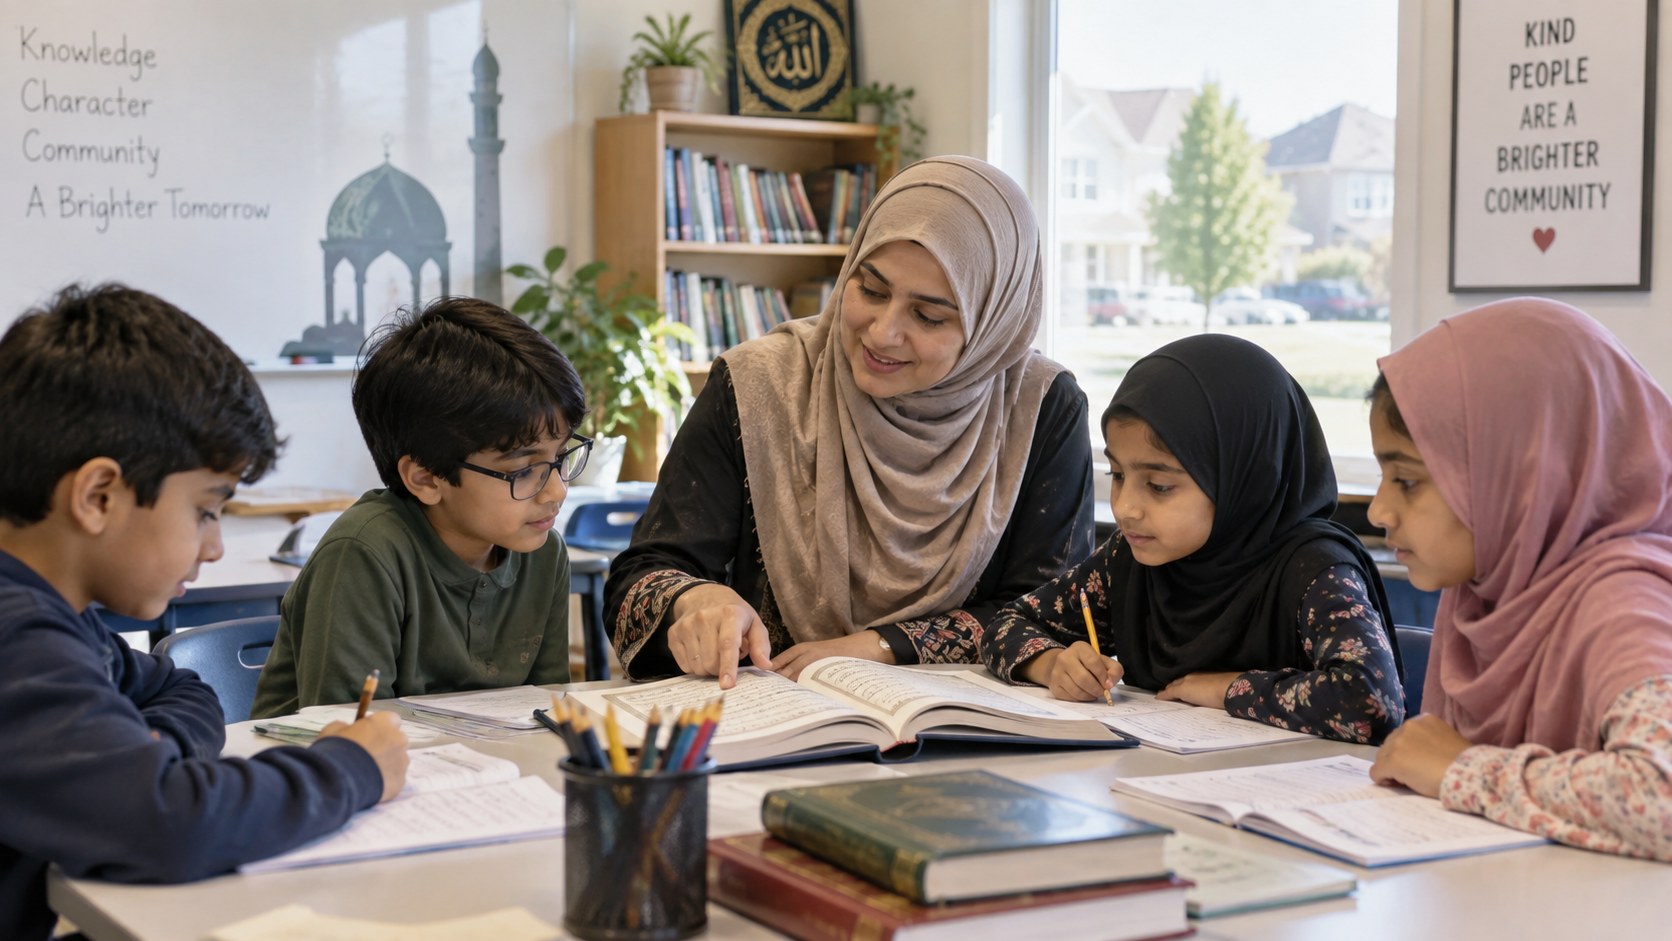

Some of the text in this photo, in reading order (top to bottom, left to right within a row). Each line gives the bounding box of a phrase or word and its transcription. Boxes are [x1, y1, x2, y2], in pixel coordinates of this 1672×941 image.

[1525, 18, 1576, 48] KIND
[20, 25, 157, 82] Knowledge
[1509, 56, 1589, 90] PEOPLE
[20, 77, 154, 118] Character
[1520, 100, 1577, 130] ARE A
[22, 128, 160, 179] Community
[1497, 140, 1599, 173] BRIGHTER
[25, 184, 270, 234] A Brighter Tomorrow
[1484, 182, 1612, 214] COMMUNITY
